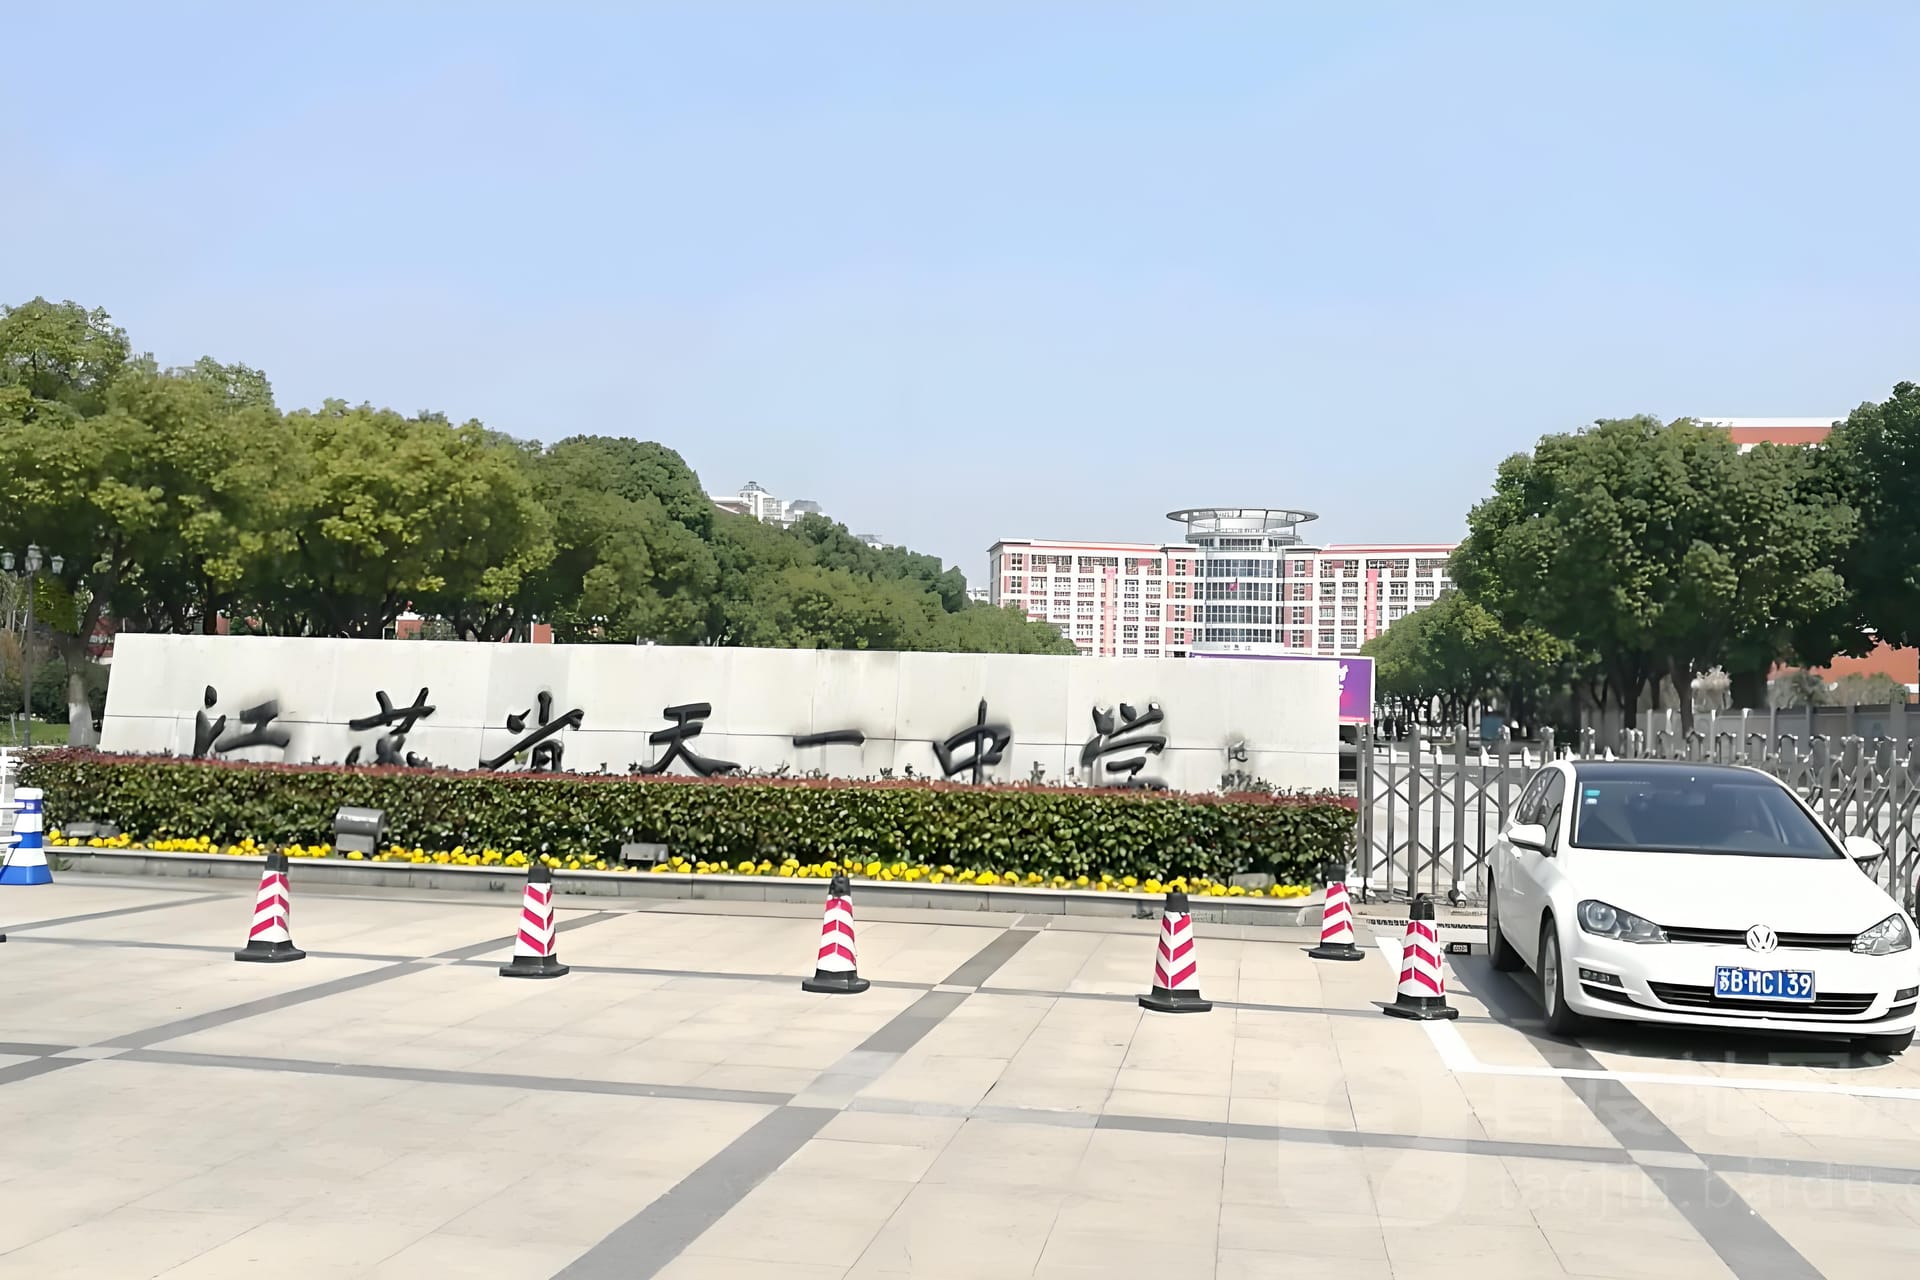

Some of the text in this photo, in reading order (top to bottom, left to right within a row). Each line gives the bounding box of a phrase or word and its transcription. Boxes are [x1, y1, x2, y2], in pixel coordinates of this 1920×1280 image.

[193, 684, 1167, 790] 江苏省天一中学
